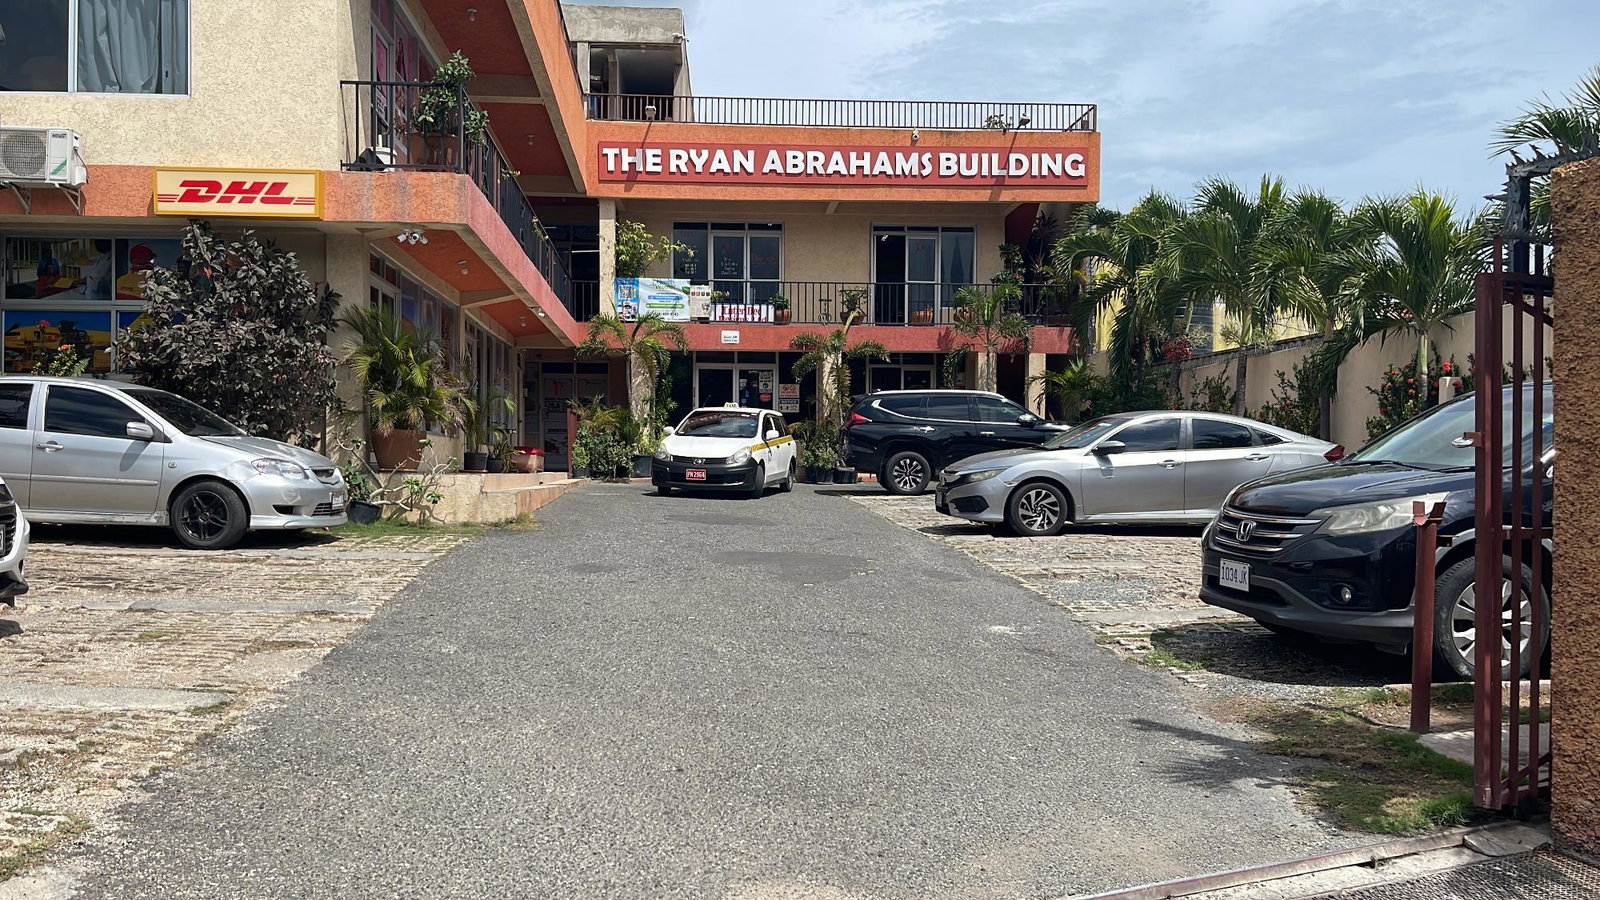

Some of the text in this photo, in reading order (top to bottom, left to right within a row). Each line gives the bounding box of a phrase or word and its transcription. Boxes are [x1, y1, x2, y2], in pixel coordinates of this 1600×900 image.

[602, 147, 1086, 177] THE RYAN ABRAHAMS BUILDING
[177, 179, 296, 205] DHL
[1221, 566, 1247, 585] 1034 JK
